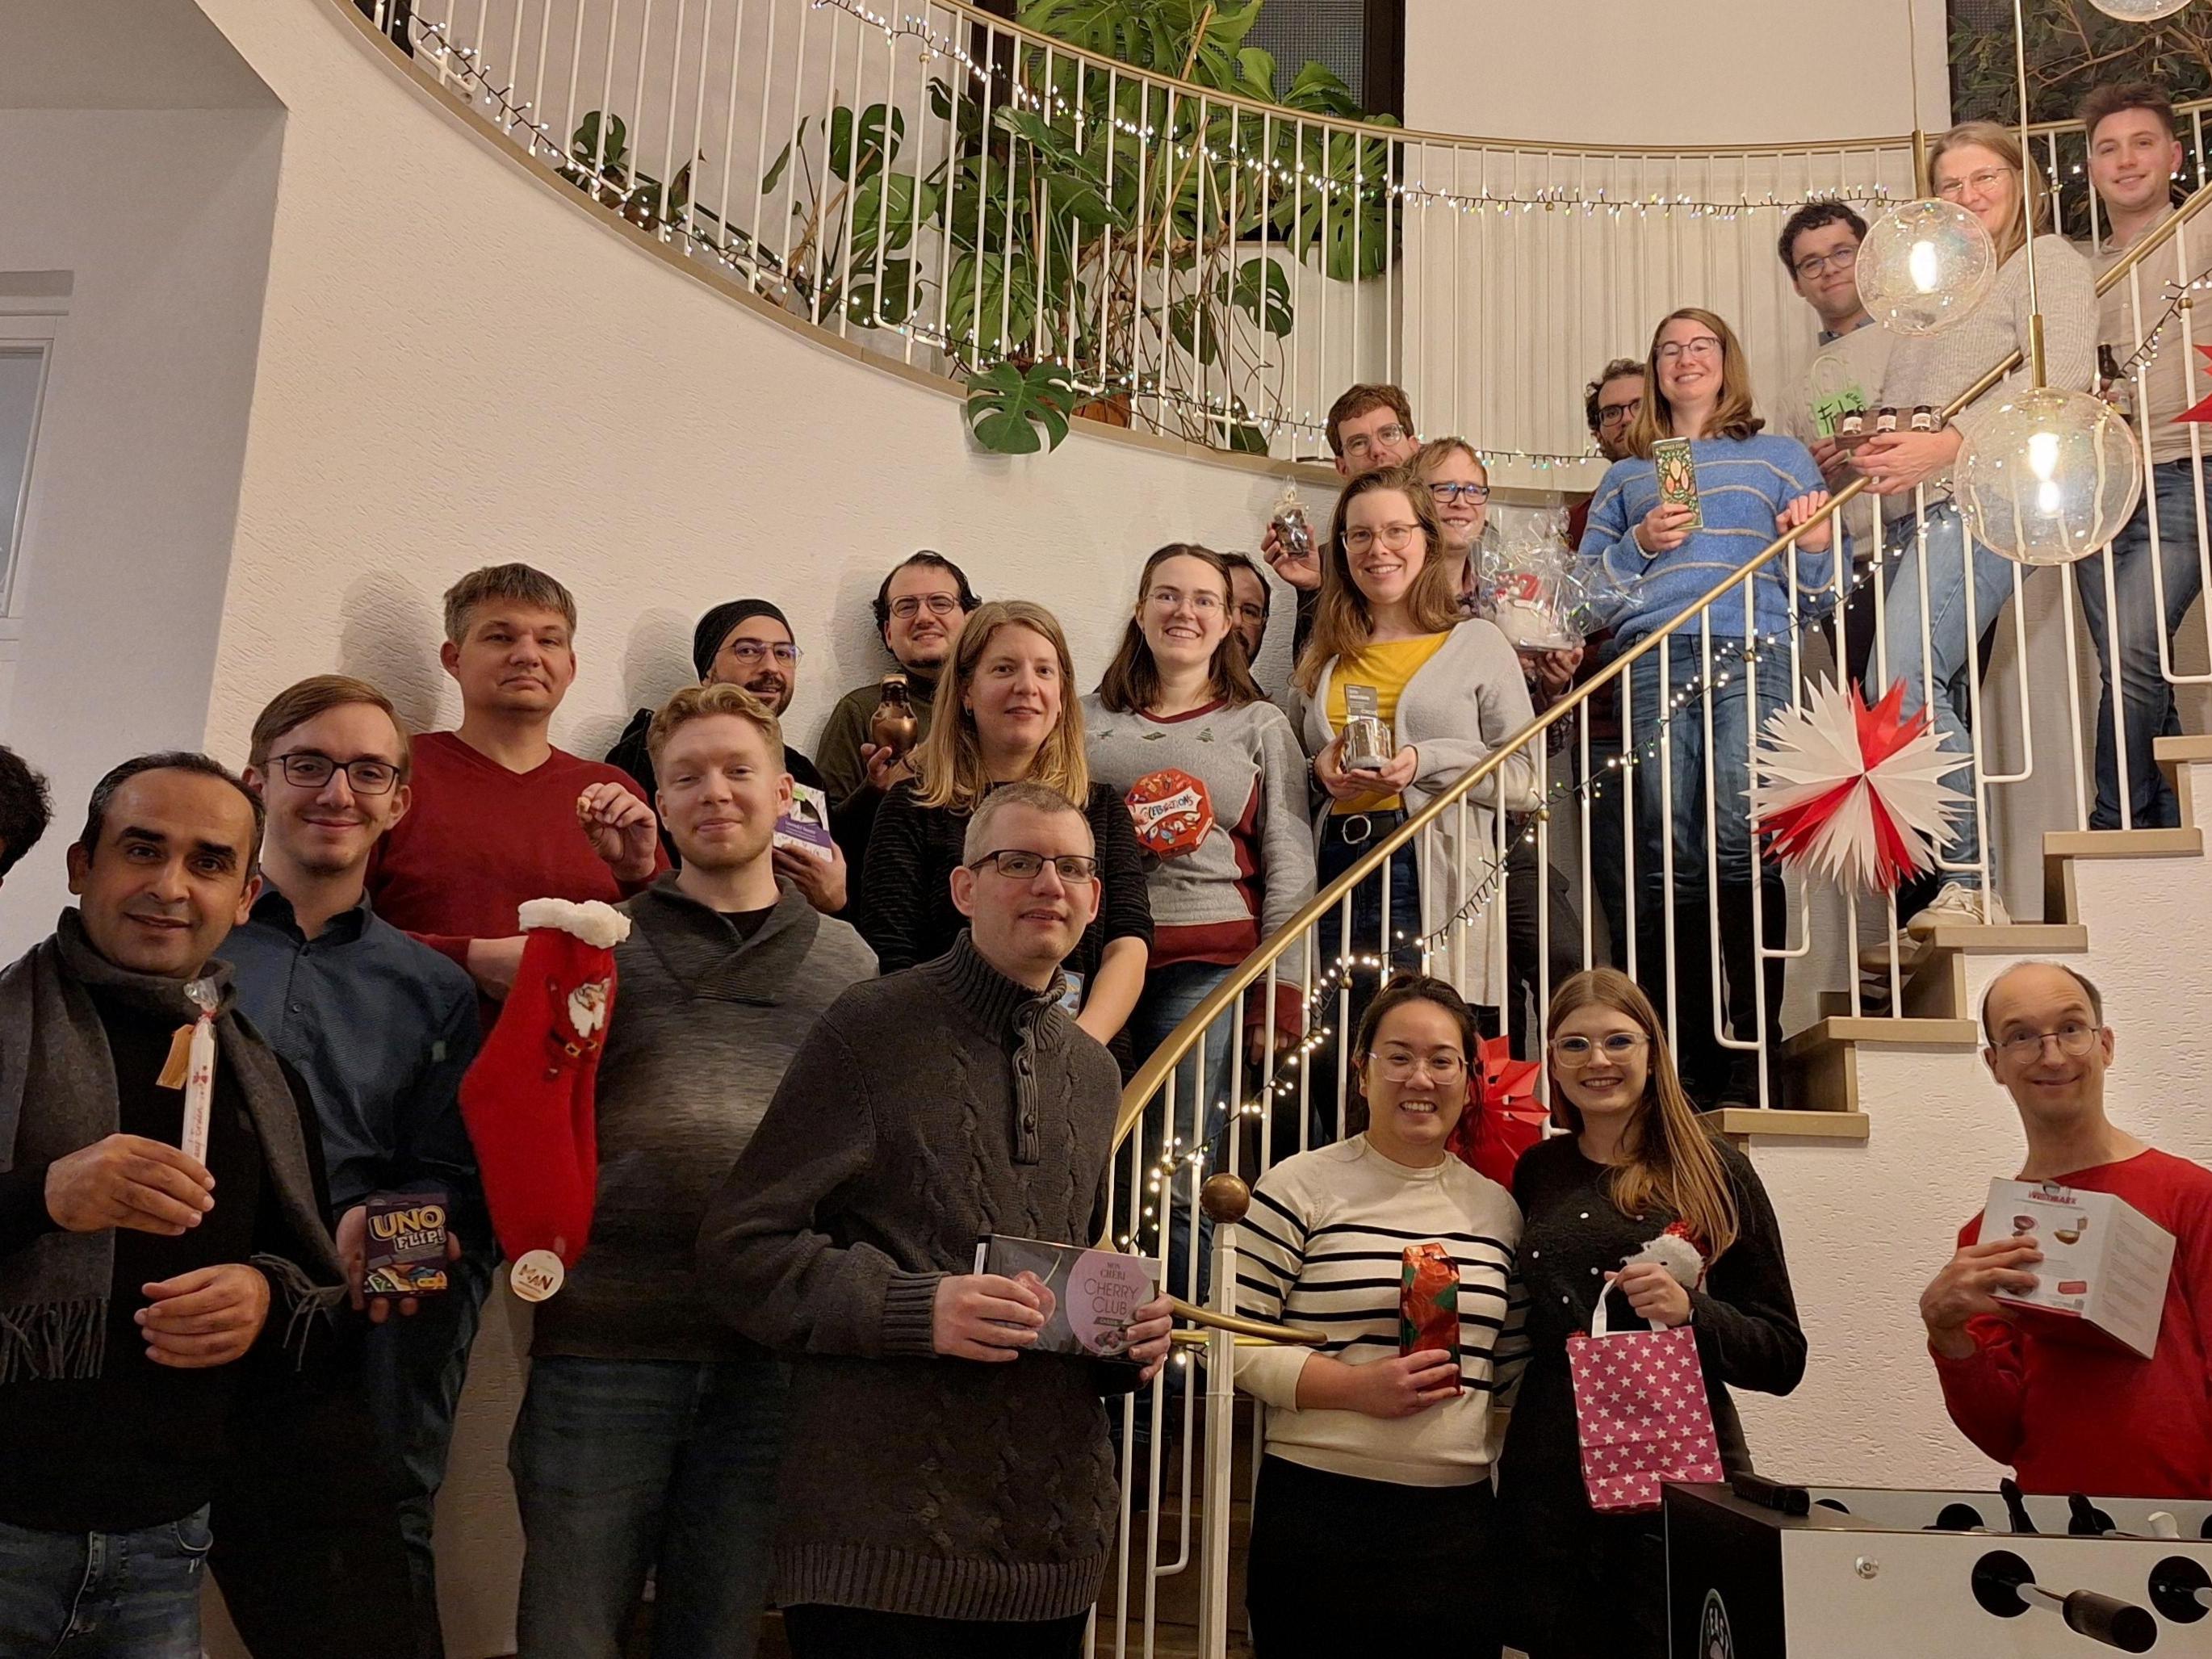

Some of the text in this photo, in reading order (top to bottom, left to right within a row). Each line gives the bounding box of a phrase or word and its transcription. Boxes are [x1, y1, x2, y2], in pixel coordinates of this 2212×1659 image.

[371, 1205, 444, 1238] UNO
[396, 1227, 444, 1250] FLIP!
[1084, 1278, 1139, 1299] CHERRY
[1092, 1296, 1127, 1315] CLUB
